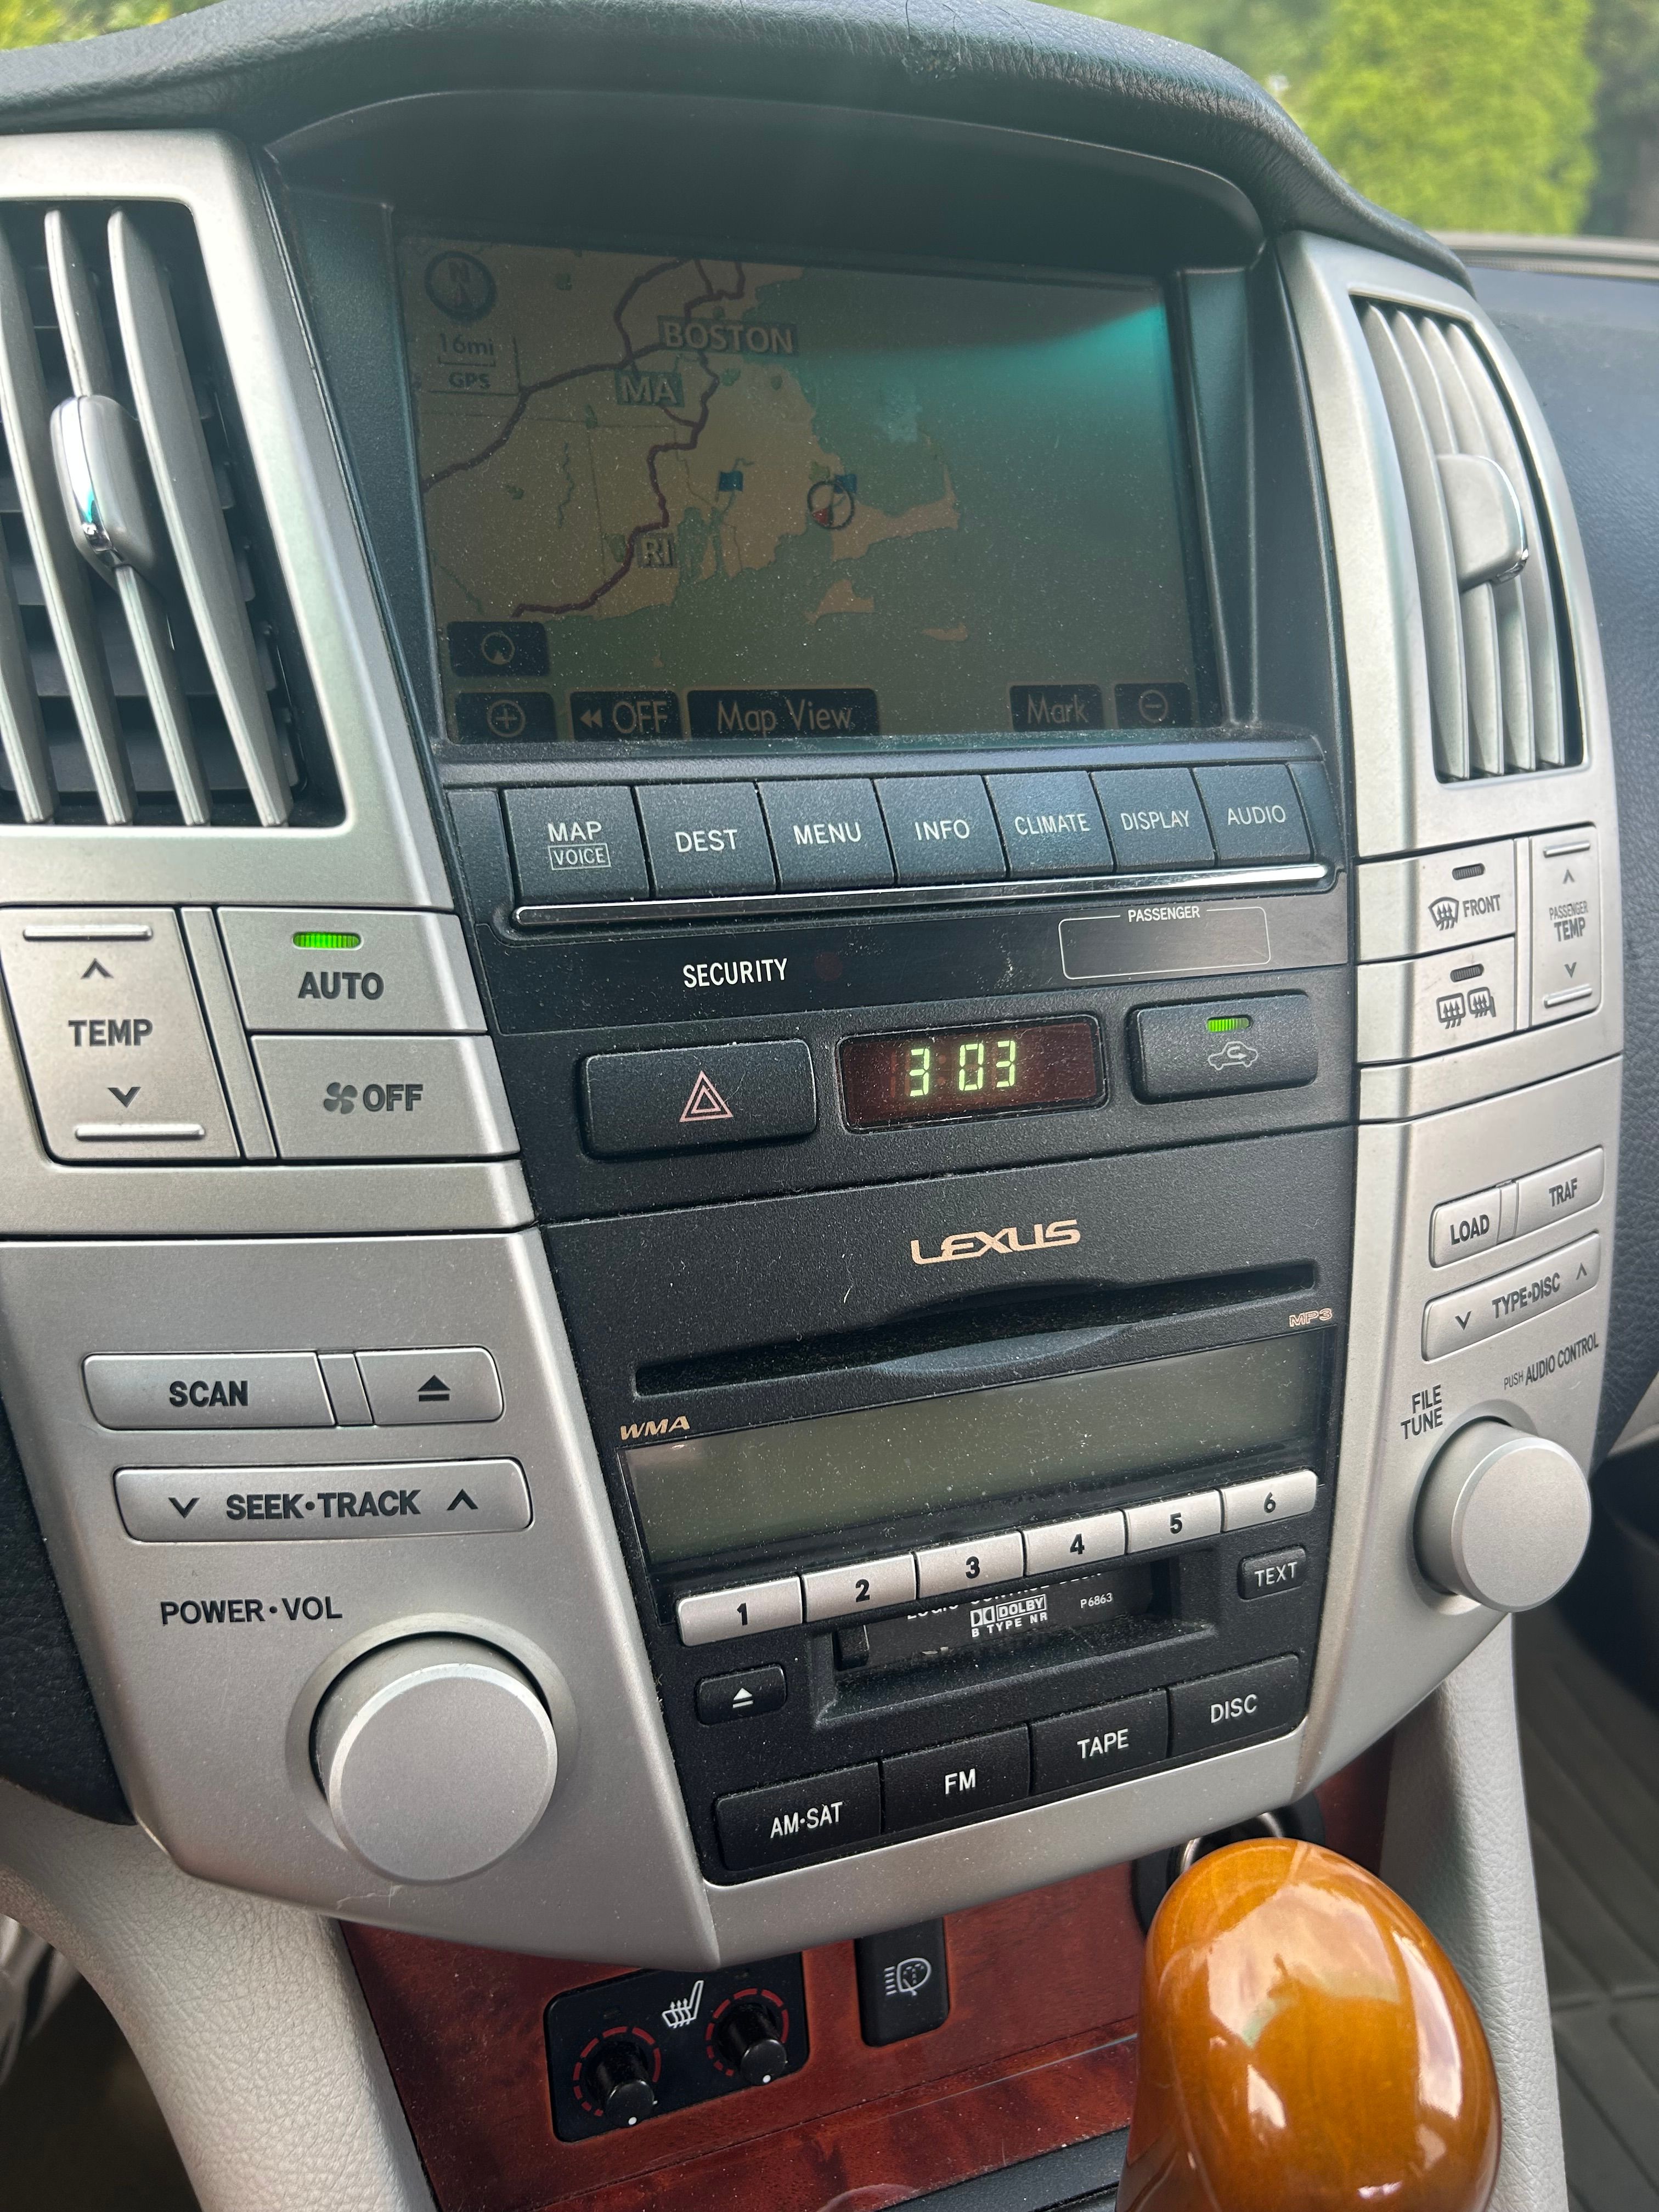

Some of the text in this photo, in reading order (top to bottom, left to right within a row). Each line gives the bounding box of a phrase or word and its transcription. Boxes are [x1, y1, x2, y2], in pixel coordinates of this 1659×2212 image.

[440, 332, 493, 356] 16mi
[663, 323, 794, 354] BOSTON
[449, 371, 490, 388] GPS
[620, 377, 677, 404] MA
[641, 538, 672, 565] RI
[613, 701, 667, 733] OFF
[718, 700, 852, 736] Map View
[1028, 697, 1088, 724] Mark
[1015, 814, 1090, 836] CLIMATE
[1121, 810, 1190, 831] DISPLAY
[1227, 805, 1286, 825] AUDIO
[549, 821, 602, 842] MAP
[675, 830, 738, 853] DEST
[794, 822, 862, 845] MENU
[915, 819, 969, 841] INFO
[554, 848, 605, 866] VOICE
[1128, 906, 1200, 922] PASSENGER
[1463, 895, 1500, 917] FRONT
[1549, 901, 1588, 921] PASSENGER
[1554, 917, 1585, 942] TEMP
[684, 958, 787, 988] SECURITY
[298, 972, 384, 1000] AUTO
[69, 1019, 153, 1047] TEMP
[363, 1084, 424, 1111] OFF
[1549, 1178, 1577, 1207] TRAF
[911, 1219, 1081, 1265] LEXUS
[1451, 1214, 1489, 1245] LOAD
[1289, 1308, 1333, 1328] MP3
[1504, 1332, 1599, 1390] PUSH AUDIO CONTROL
[170, 1381, 249, 1408] SCAN
[1412, 1385, 1442, 1414] FILE
[620, 1415, 690, 1440] WMA
[1401, 1406, 1443, 1440] TUNE
[1263, 1492, 1276, 1514] 6
[1170, 1513, 1183, 1534] 5
[1070, 1533, 1085, 1556] 4
[966, 1556, 980, 1579] 3
[1254, 1561, 1298, 1588] TEXT
[855, 1579, 871, 1602] 2
[1080, 1593, 1113, 1609] P6863
[737, 1603, 748, 1626] 1
[999, 1598, 1042, 1618] DOLBY
[971, 1612, 1048, 1638] B TYPE NR
[1210, 1694, 1258, 1724] DISC
[1077, 1729, 1129, 1759] TAPE
[945, 1768, 977, 1795] FM
